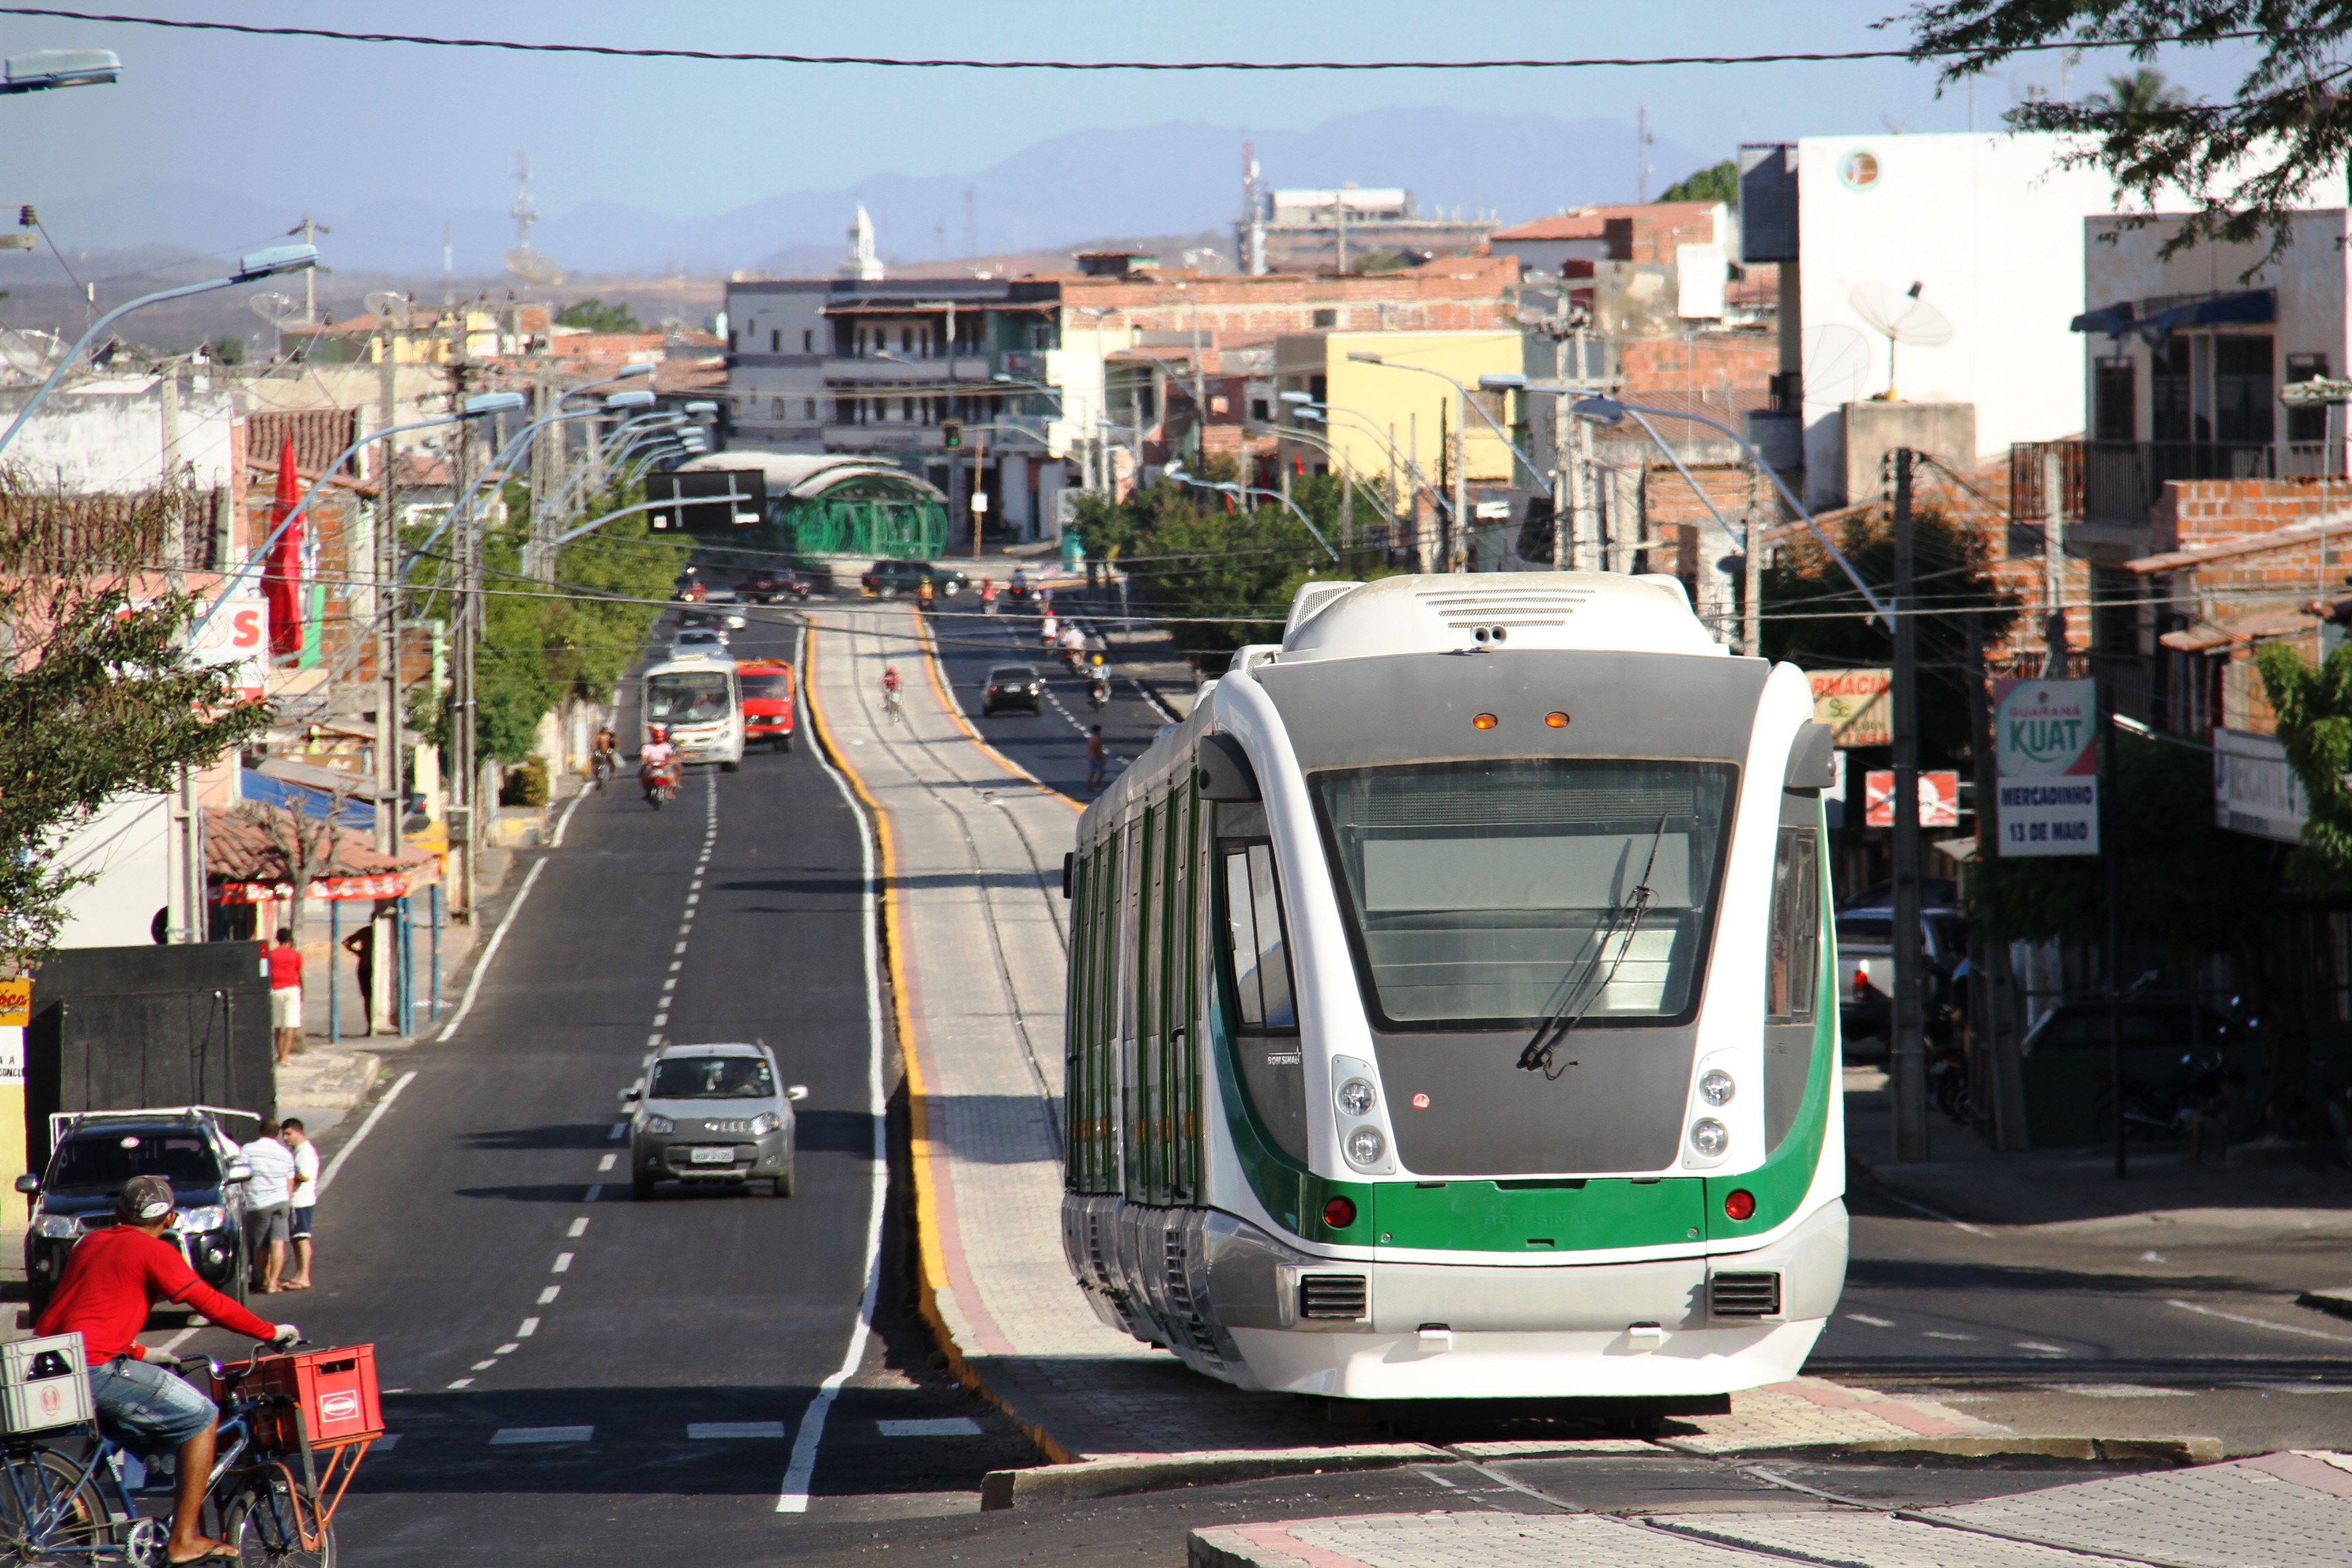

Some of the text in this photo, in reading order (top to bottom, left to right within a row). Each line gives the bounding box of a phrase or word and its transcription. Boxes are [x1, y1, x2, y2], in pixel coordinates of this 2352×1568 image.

[2010, 719, 2082, 762] KUAT
[2001, 787, 2093, 806] MERCADINHO
[2010, 821, 2088, 841] 13 DE MAIO
[1268, 1056, 1298, 1065] BOM SINAL
